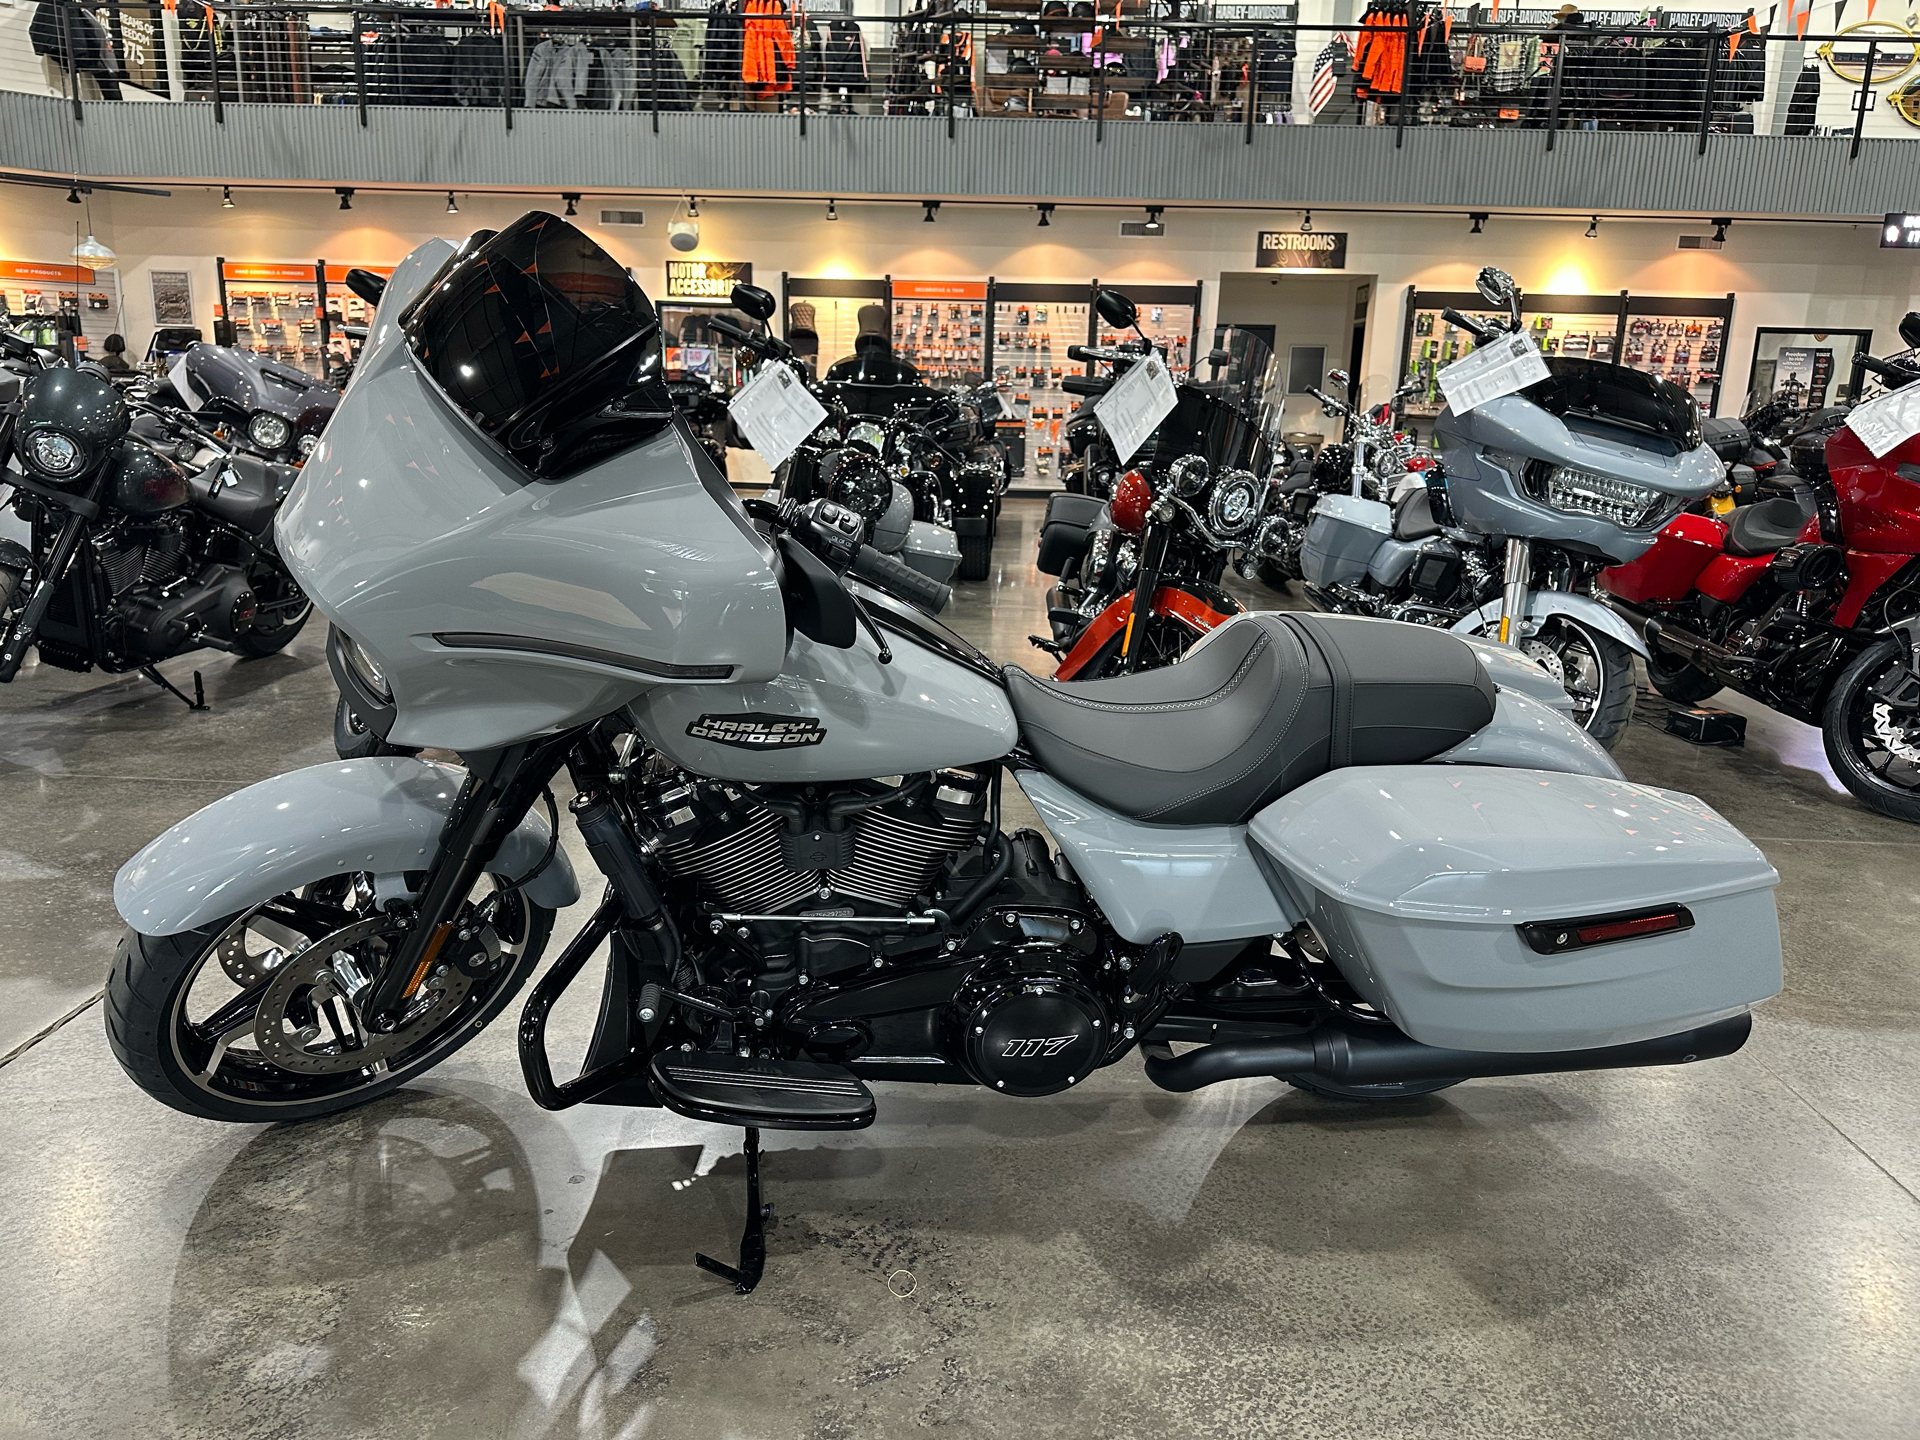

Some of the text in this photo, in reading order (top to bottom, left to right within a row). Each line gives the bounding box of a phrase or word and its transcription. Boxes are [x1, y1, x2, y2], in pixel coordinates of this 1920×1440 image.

[1262, 233, 1336, 251] RESTROOMS
[30, 268, 62, 276] PRODUCTS
[669, 262, 707, 279] MOTOR
[669, 278, 743, 296] ACCESSORIE
[702, 718, 813, 733] HARLEY-
[690, 726, 821, 743] DAVIDSON
[1001, 1034, 1079, 1057] 117
